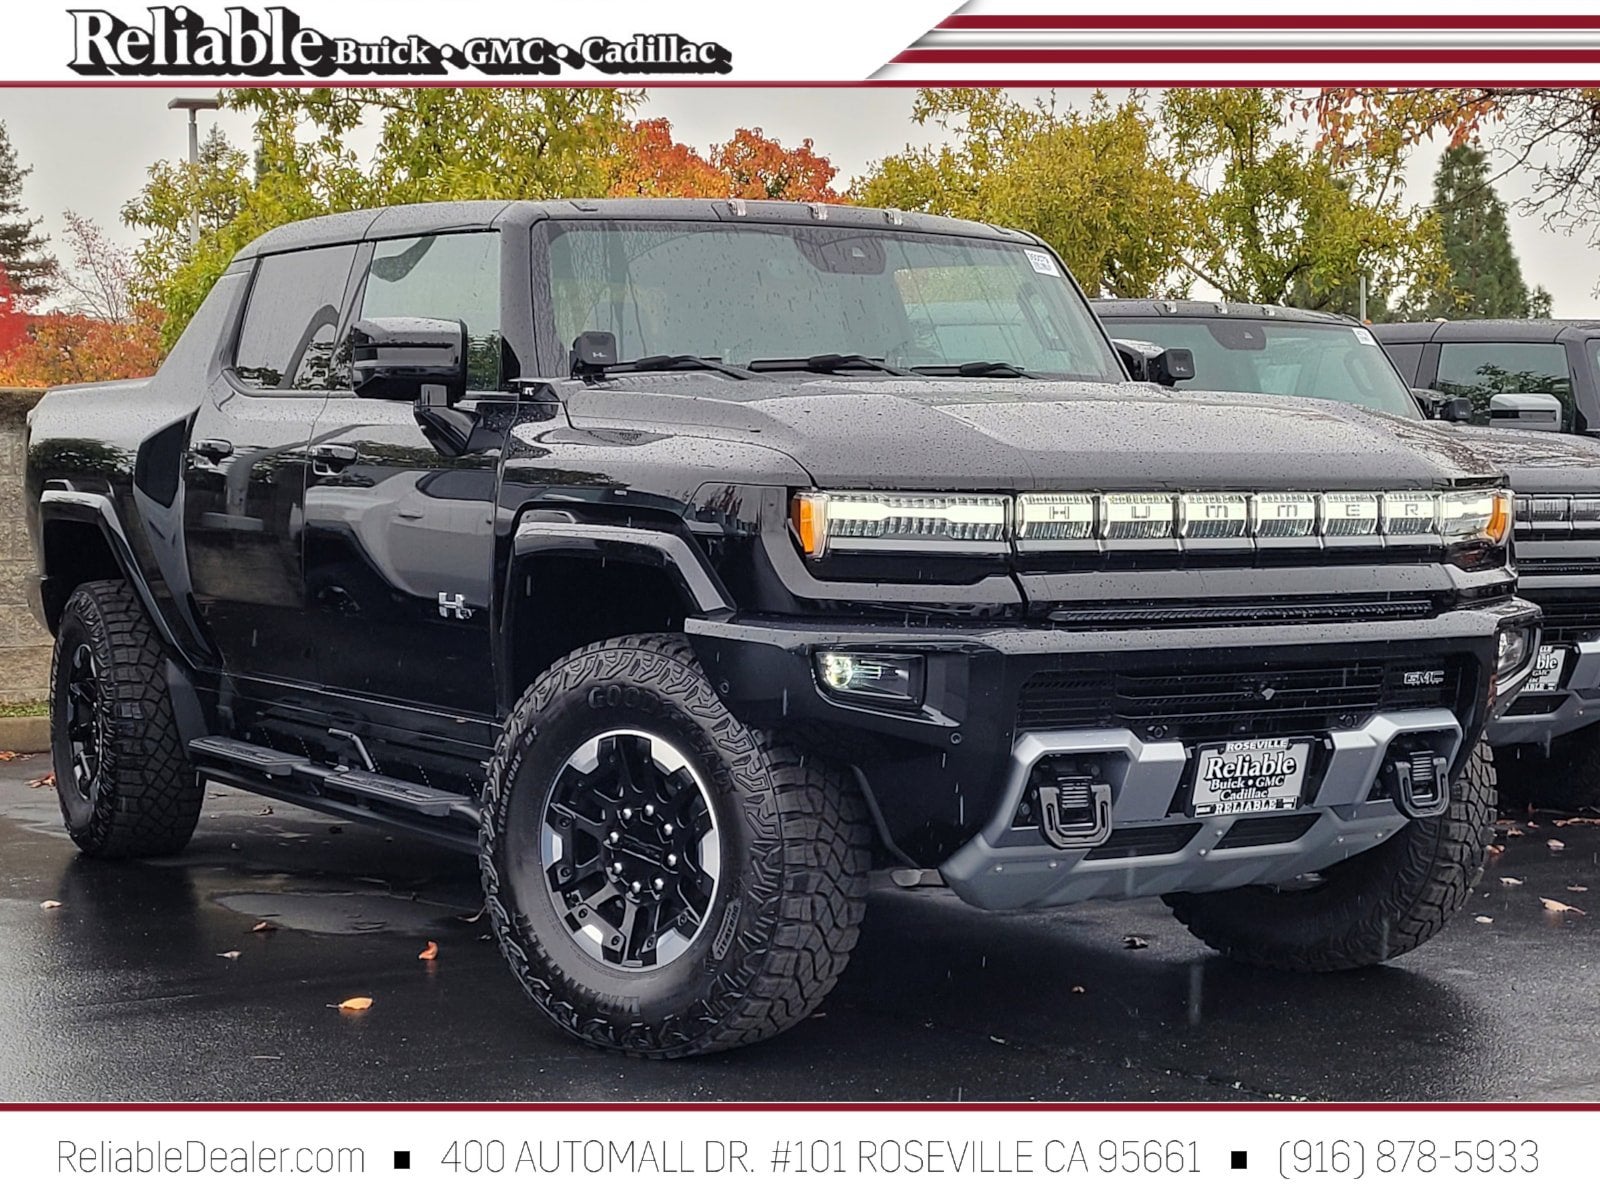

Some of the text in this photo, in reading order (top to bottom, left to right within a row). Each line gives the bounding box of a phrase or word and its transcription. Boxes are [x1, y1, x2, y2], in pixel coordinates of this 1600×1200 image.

[1404, 670, 1444, 686] GMC
[1227, 739, 1287, 752] ROSEVILLE
[1204, 752, 1296, 780] Reliable
[1211, 775, 1285, 791] Buick GMC
[1220, 788, 1268, 801] Cadillac
[1215, 800, 1277, 815] RELIABLE
